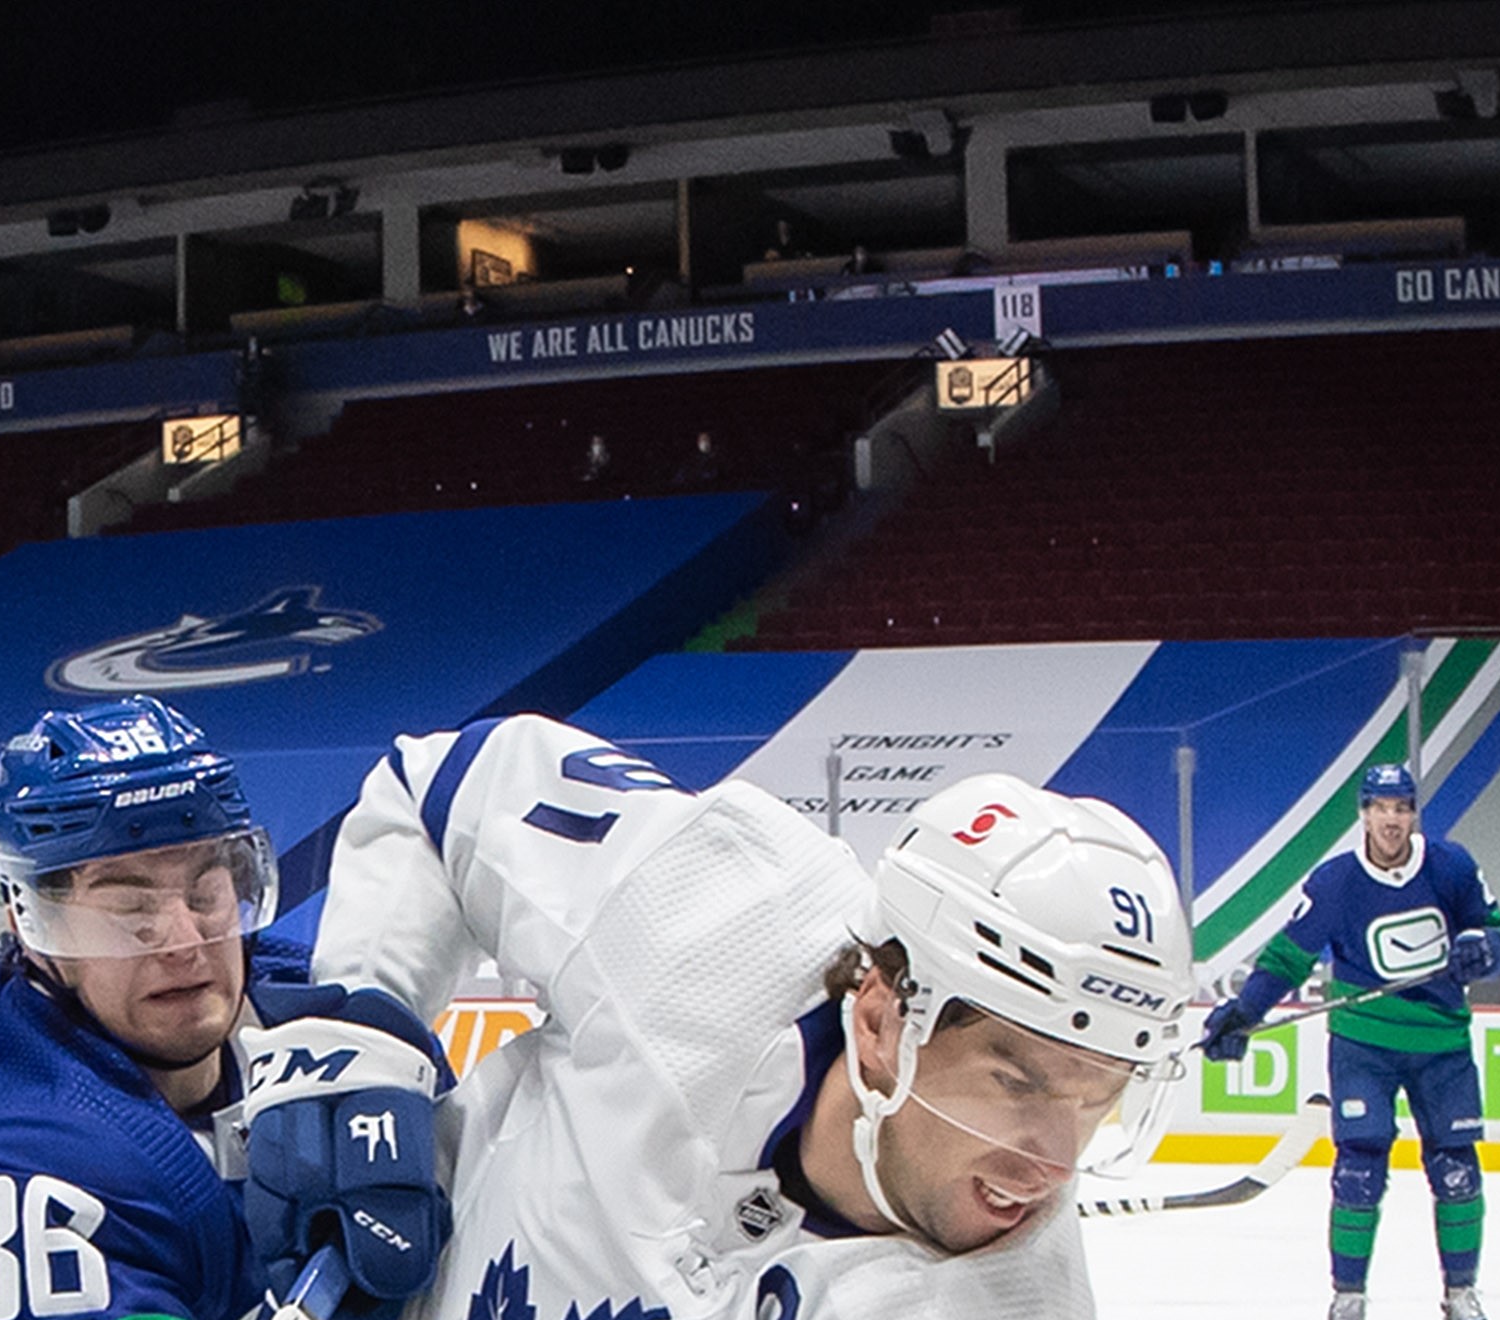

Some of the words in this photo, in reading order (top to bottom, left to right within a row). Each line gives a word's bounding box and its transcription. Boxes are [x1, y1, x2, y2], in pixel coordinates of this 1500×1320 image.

[1000, 293, 1035, 318] 118
[1396, 270, 1434, 302] GO
[488, 330, 523, 362] WE
[532, 324, 577, 360] ARE
[586, 320, 629, 355] ALL
[637, 311, 756, 350] CANUCKS
[837, 733, 1012, 750] TONIGHT'S
[844, 765, 945, 782] GAME
[114, 780, 196, 808] BAUER
[1109, 887, 1154, 943] 91
[1080, 973, 1166, 1013] CCM
[249, 1047, 361, 1091] CM
[348, 1111, 399, 1163] 91
[352, 1209, 413, 1251] CCM
